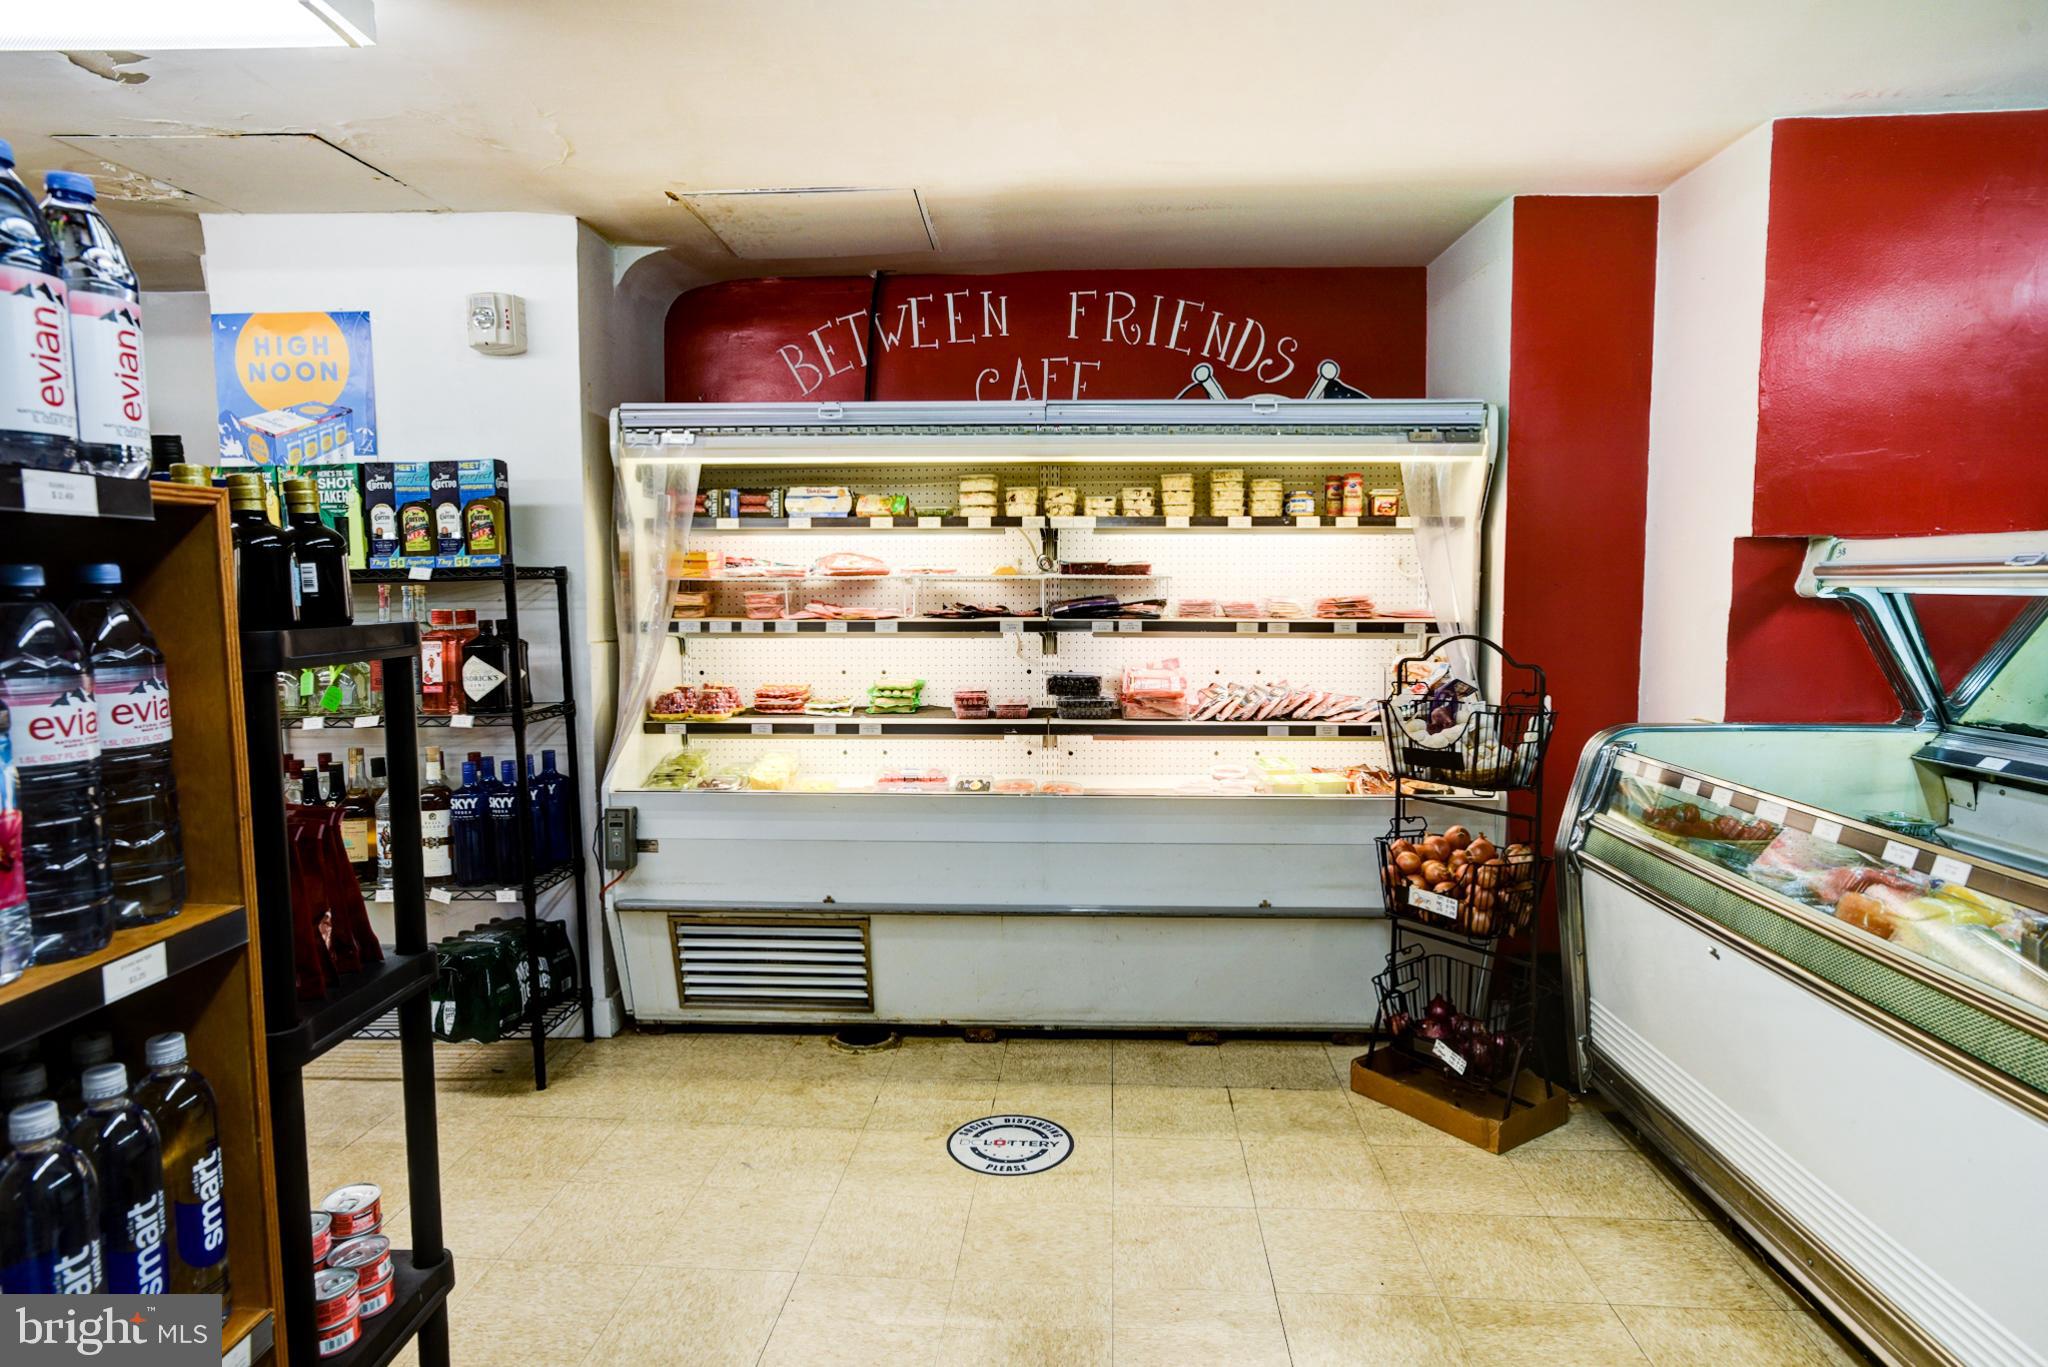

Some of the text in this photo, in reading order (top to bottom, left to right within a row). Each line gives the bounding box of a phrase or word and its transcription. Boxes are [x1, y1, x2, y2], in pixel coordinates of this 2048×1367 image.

[31, 306, 64, 407] evian
[253, 335, 330, 357] HIGH
[776, 288, 1299, 397] BETWEEN FRIENDS
[115, 329, 142, 422] evian
[247, 361, 339, 383] NOON
[975, 356, 1101, 402] CAFE
[317, 477, 354, 489] SHOT
[28, 708, 98, 741] evia
[111, 696, 171, 725] evia
[450, 797, 478, 810] SKYY
[488, 796, 515, 809] SKYY
[958, 1117, 1064, 1138] SOCIAL DISTANCING
[983, 1138, 1060, 1148] LOTTERY
[985, 1163, 1028, 1172] PLEASE
[192, 1149, 224, 1252] smart
[127, 1193, 164, 1294] smart
[54, 1244, 92, 1294] art
